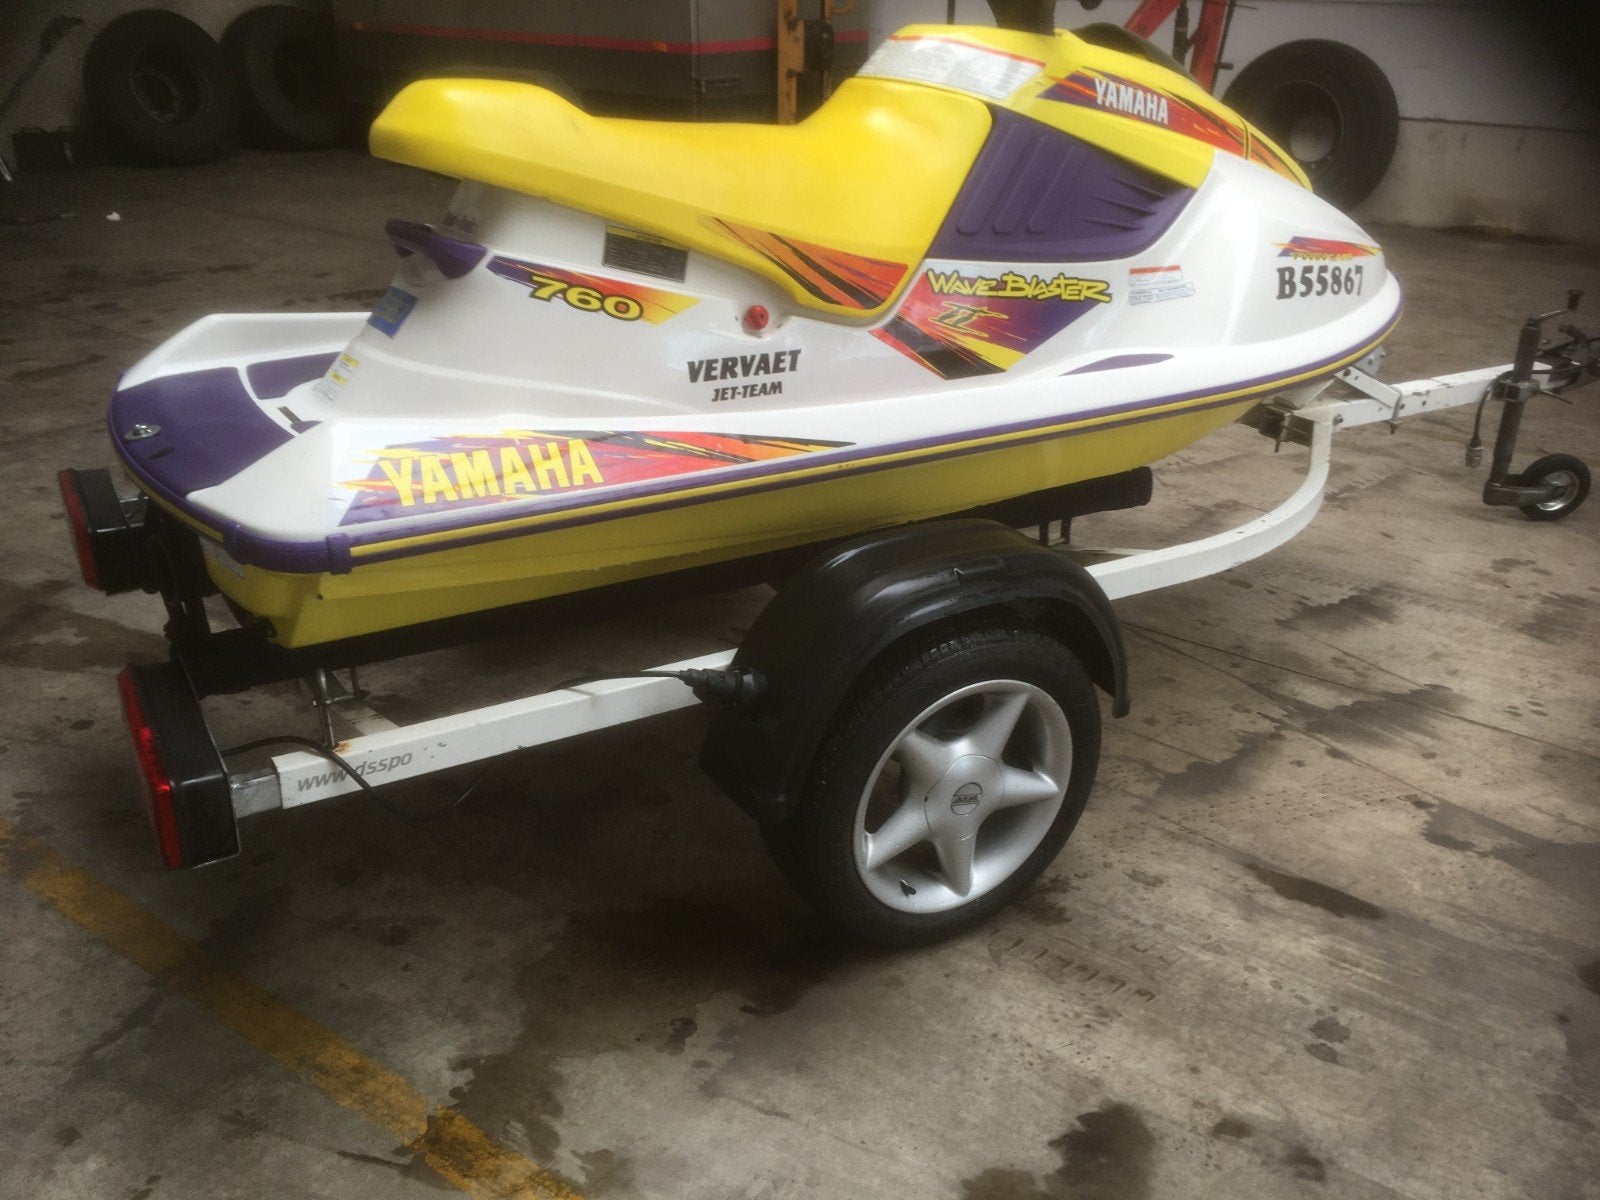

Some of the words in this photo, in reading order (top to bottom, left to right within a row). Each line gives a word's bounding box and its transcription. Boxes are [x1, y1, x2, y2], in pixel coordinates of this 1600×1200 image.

[1093, 76, 1170, 125] YAMAHA
[528, 273, 643, 321] 760
[1276, 265, 1364, 300] B55867
[687, 348, 802, 384] VERVAET
[711, 380, 783, 403] JET-TEAM
[377, 438, 604, 507] YAMAHA
